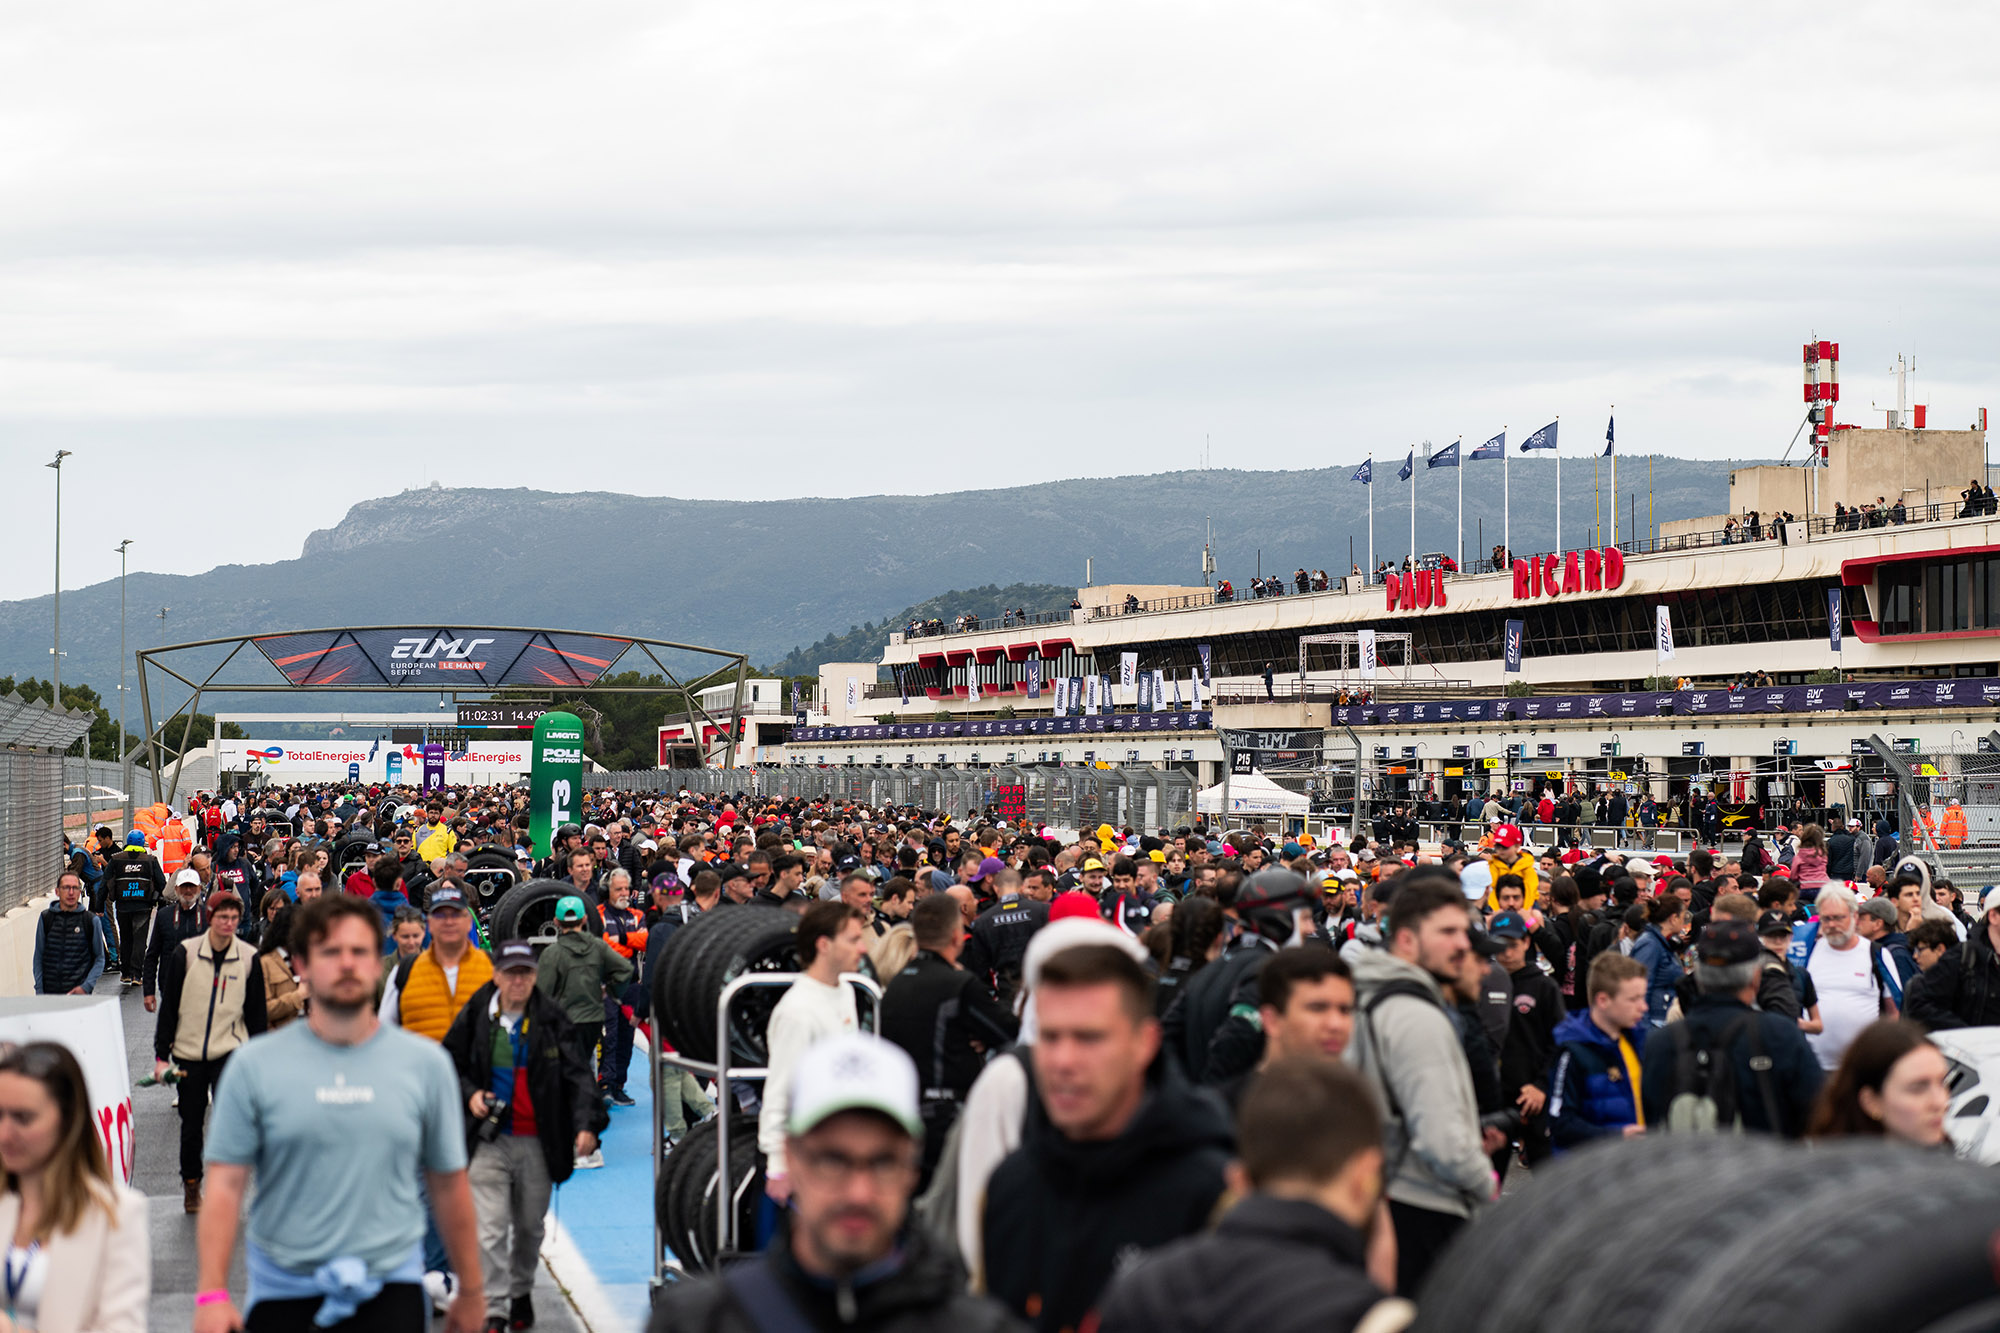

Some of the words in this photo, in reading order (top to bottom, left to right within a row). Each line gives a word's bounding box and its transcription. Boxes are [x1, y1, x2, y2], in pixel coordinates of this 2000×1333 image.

[1386, 568, 1446, 611] PAUL
[1513, 547, 1624, 599] RICARD
[391, 638, 495, 659] ELMS
[459, 710, 503, 721] 11:02:31
[546, 732, 580, 740] LMGT3
[286, 751, 366, 764] TotalEnergies
[444, 752, 522, 764] TalEnergies
[543, 748, 580, 757] POLE
[1236, 753, 1251, 766] P15
[999, 785, 1011, 795] 99
[1012, 785, 1024, 795] P8
[1000, 795, 1023, 804] -4.37
[131, 889, 145, 897] LANE
